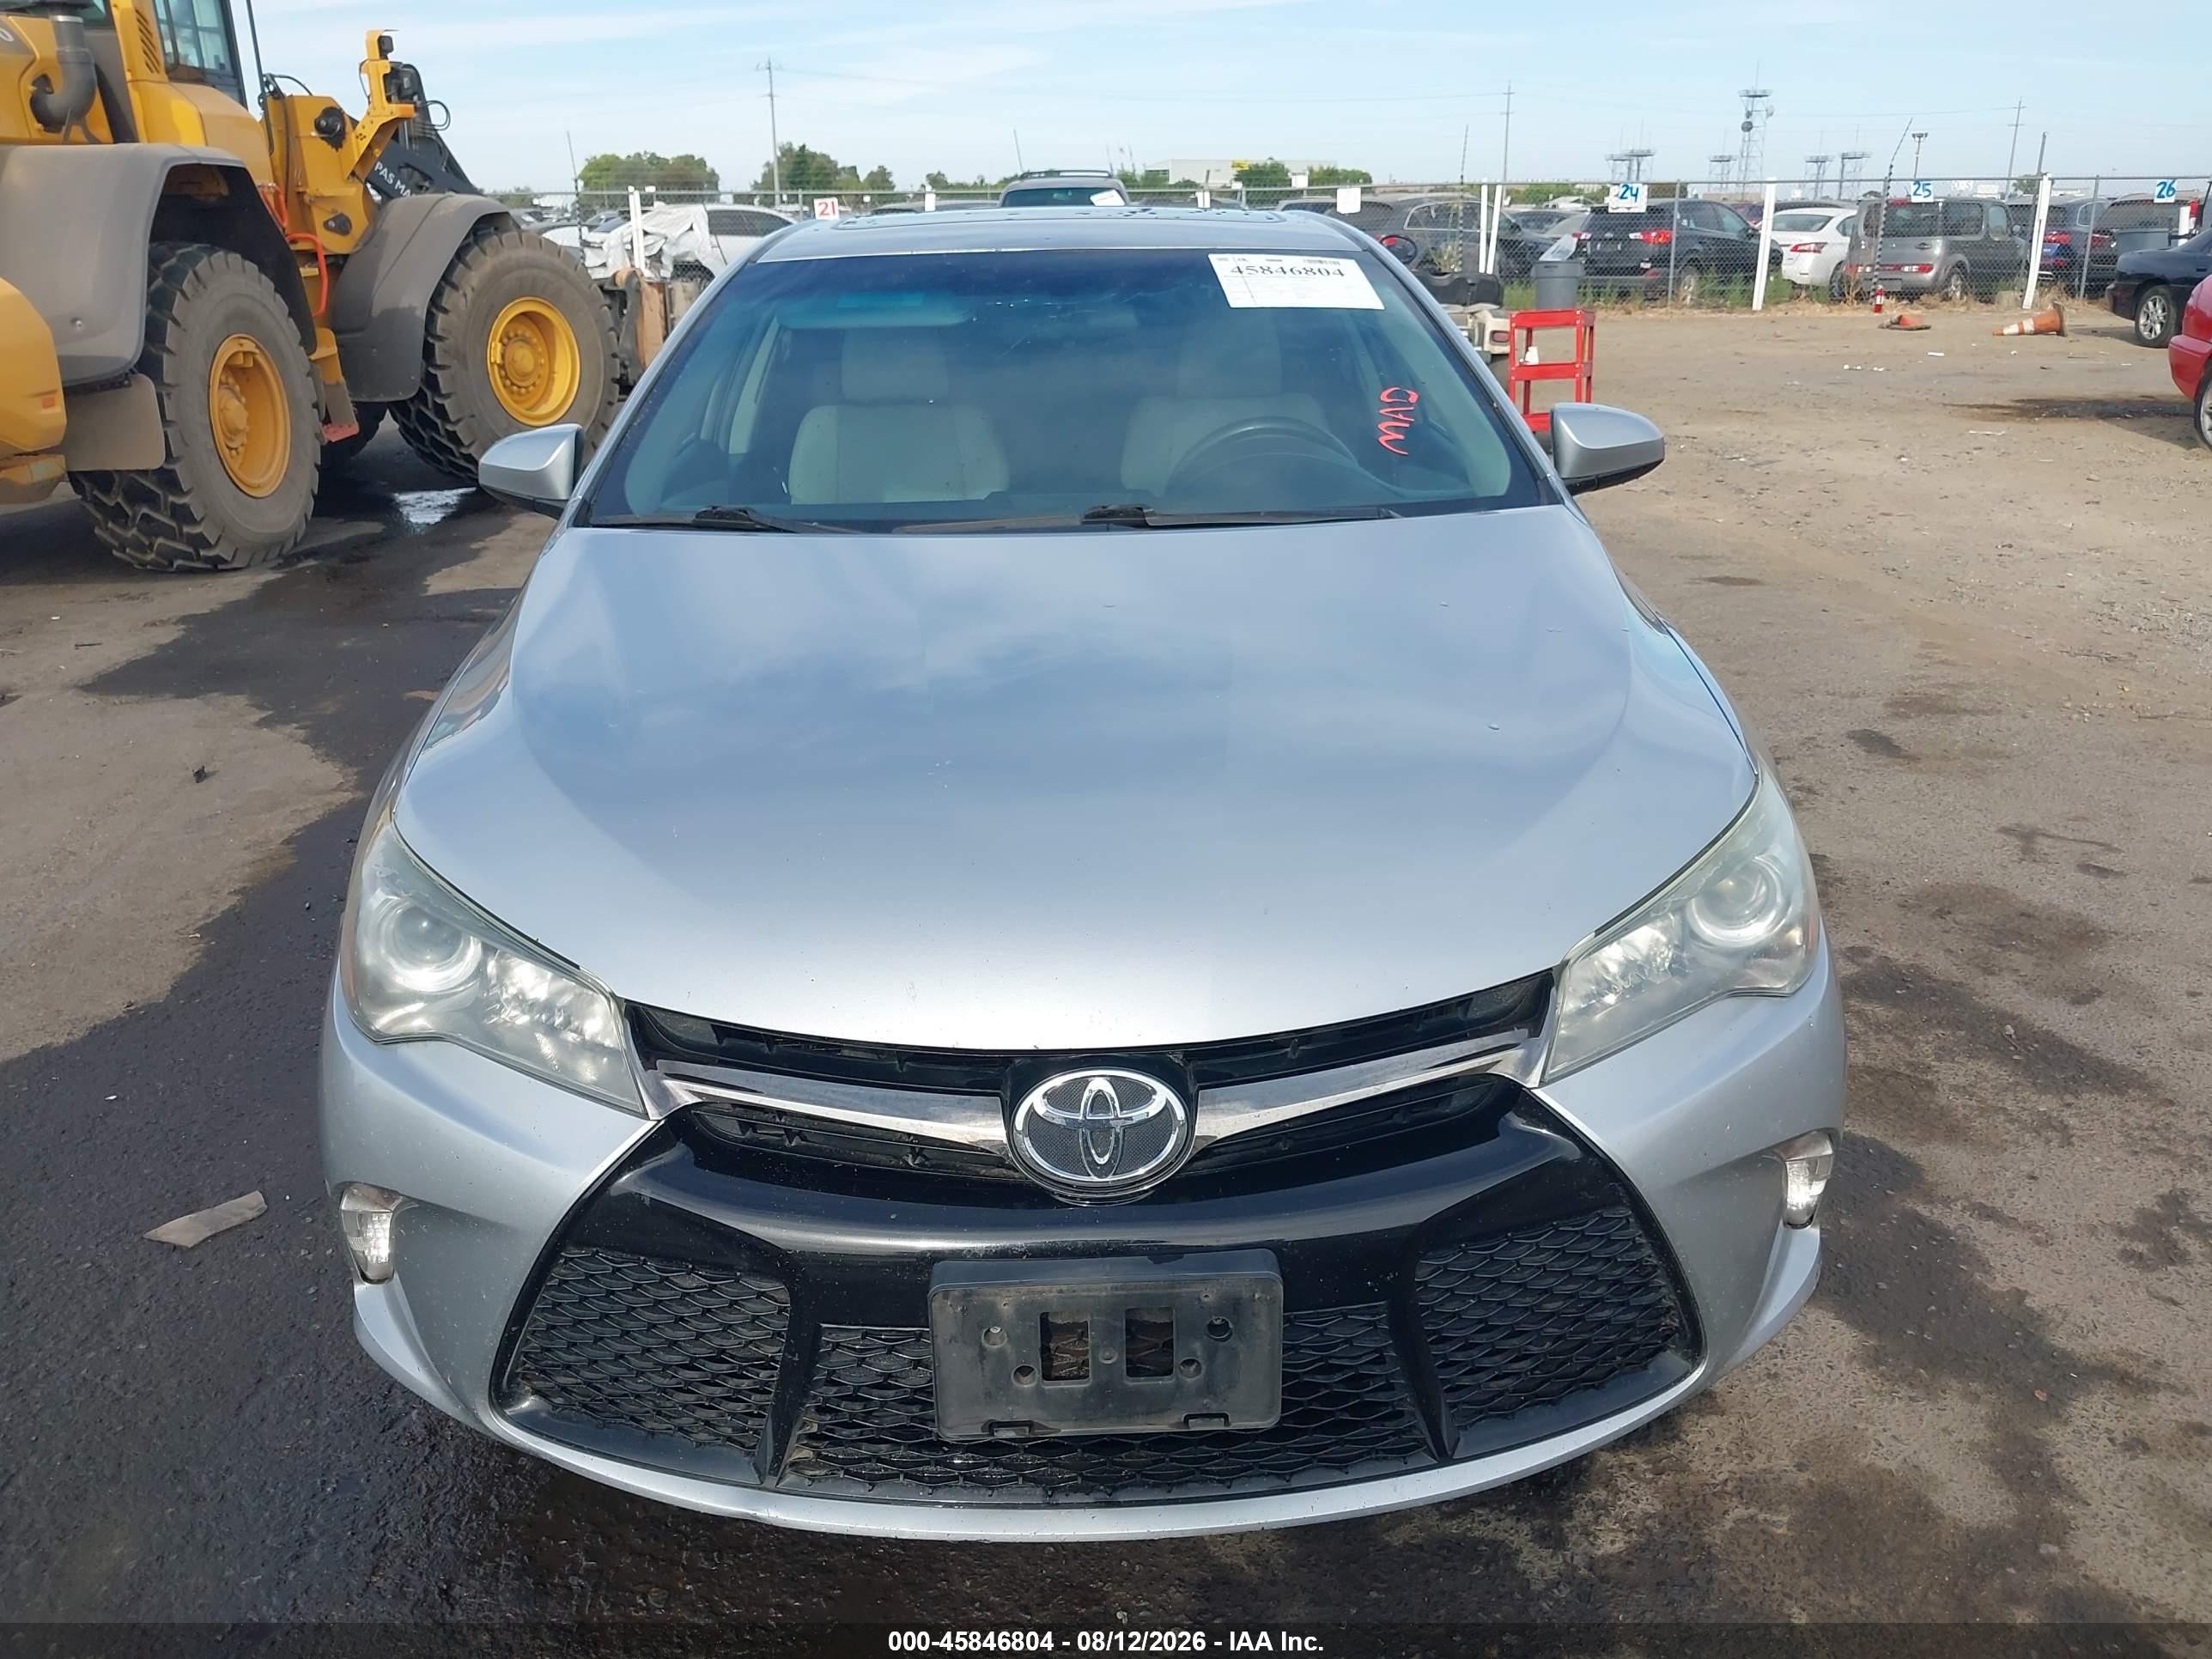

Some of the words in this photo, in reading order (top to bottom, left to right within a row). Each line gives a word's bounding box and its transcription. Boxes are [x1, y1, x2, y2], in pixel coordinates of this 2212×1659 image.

[374, 161, 395, 185] PAS
[1620, 184, 1639, 203] 24
[1912, 179, 1932, 198] 25
[2156, 179, 2176, 198] 26
[817, 201, 836, 216] 21
[1230, 264, 1346, 277] 45846804
